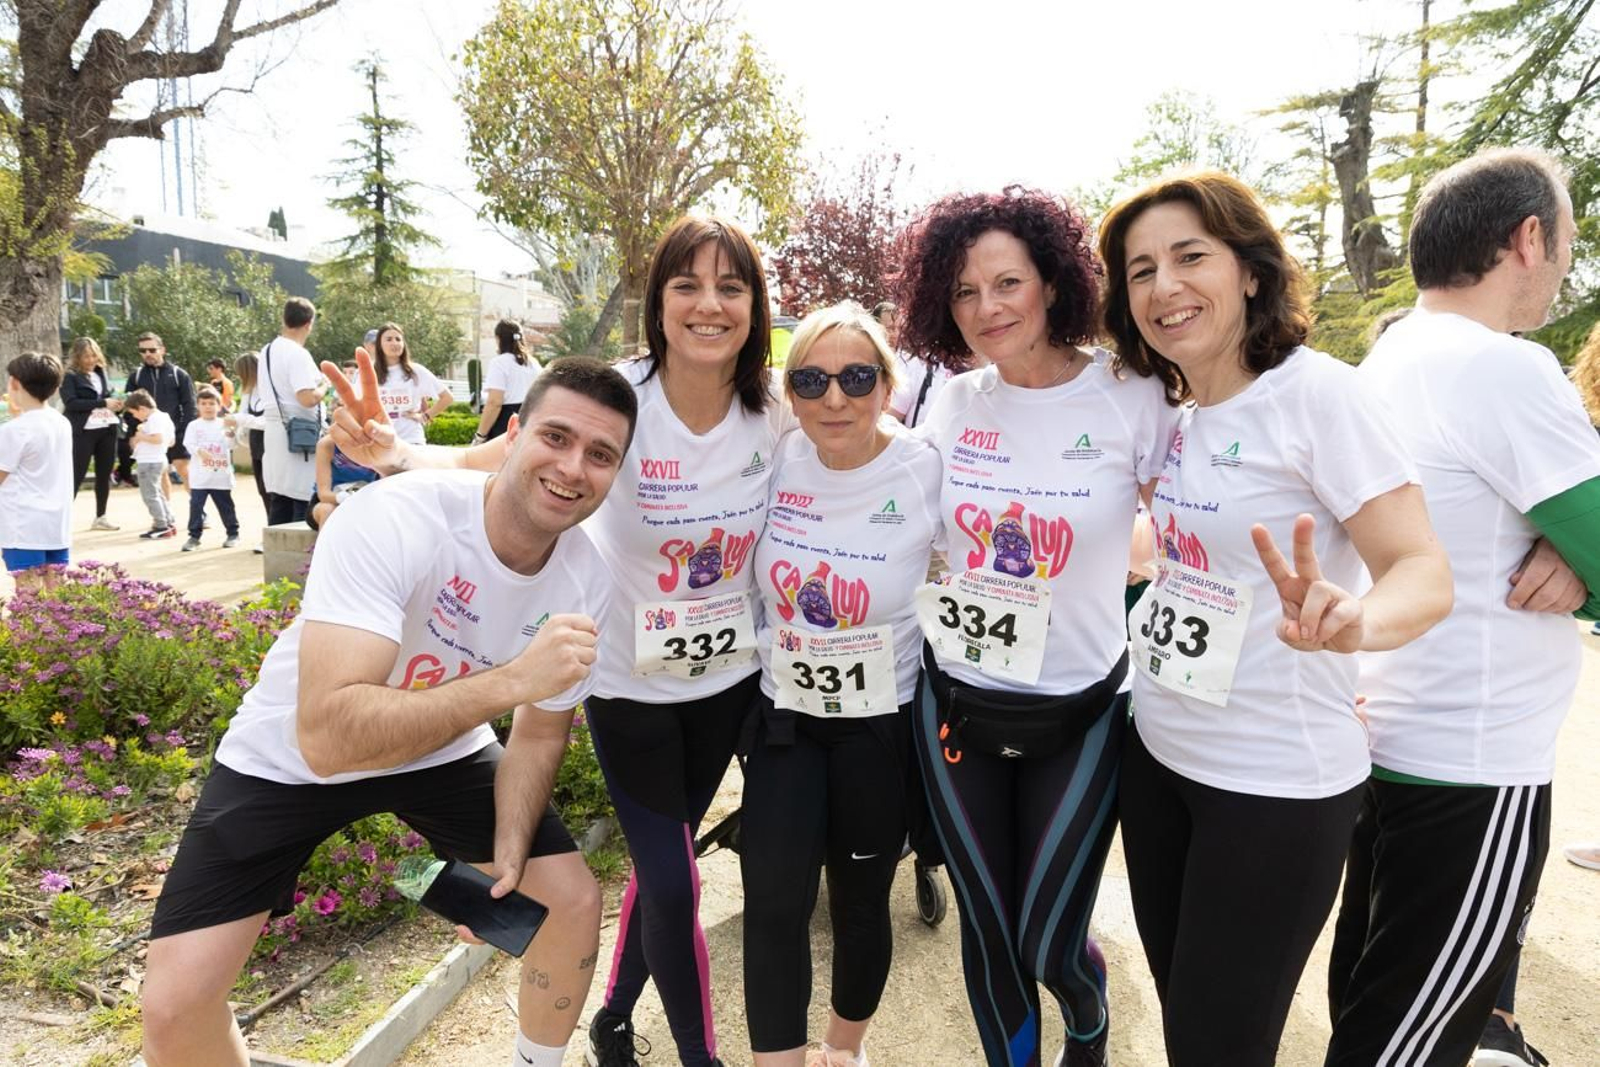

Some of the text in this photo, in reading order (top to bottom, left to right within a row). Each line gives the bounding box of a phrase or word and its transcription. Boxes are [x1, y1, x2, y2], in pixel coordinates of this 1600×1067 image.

[381, 396, 409, 405] 5385
[958, 427, 1000, 451] XXVII
[953, 445, 1011, 464] CARRERA POPULAR
[640, 459, 681, 480] XXVII
[638, 482, 699, 492] CARRERA POPULAR
[1045, 490, 1057, 498] por
[1071, 488, 1090, 497] salud
[642, 515, 664, 526] Porque
[666, 515, 681, 525] cada
[954, 502, 1074, 579] SALUD
[657, 529, 756, 593] SALUD
[870, 553, 886, 562] salud
[769, 559, 870, 627] SALUD
[980, 574, 1007, 587] CARRERA
[1007, 580, 1036, 593] POPULAR
[1205, 580, 1236, 597] POPULAR
[938, 596, 1018, 647] 334
[1141, 599, 1210, 658] 333
[662, 628, 737, 661] 332
[791, 661, 866, 694] 331
